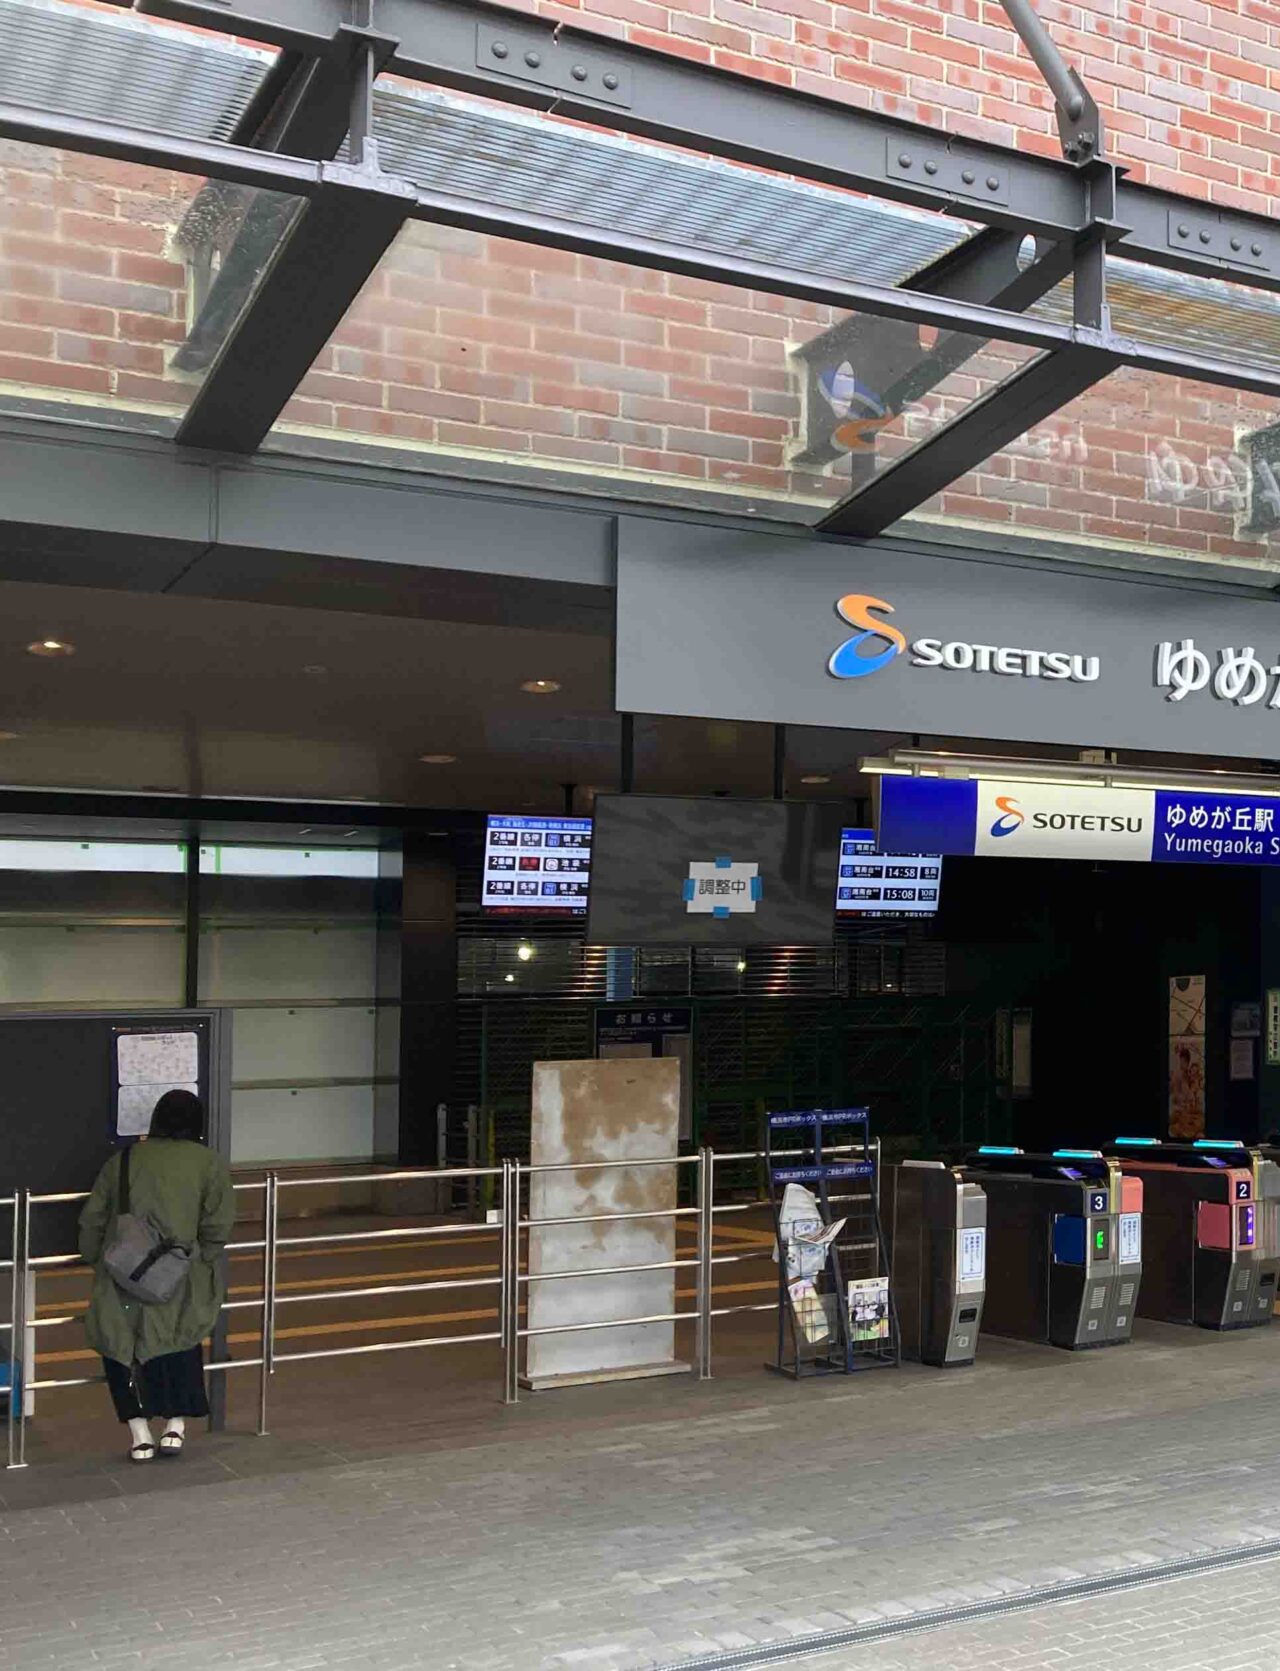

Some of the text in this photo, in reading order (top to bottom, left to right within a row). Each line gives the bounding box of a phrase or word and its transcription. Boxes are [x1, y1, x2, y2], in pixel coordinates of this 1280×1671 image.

[912, 638, 1099, 682] SOTETSU
[1033, 813, 1143, 833] SOTETSU
[1167, 804, 1274, 832] ゆめが丘駅
[1164, 832, 1264, 858] Yumegaoka
[888, 868, 916, 878] 14:58
[698, 879, 746, 895] 調整中
[886, 889, 914, 899] 15:08
[1239, 1183, 1248, 1198] 2
[1094, 1195, 1104, 1210] 3
